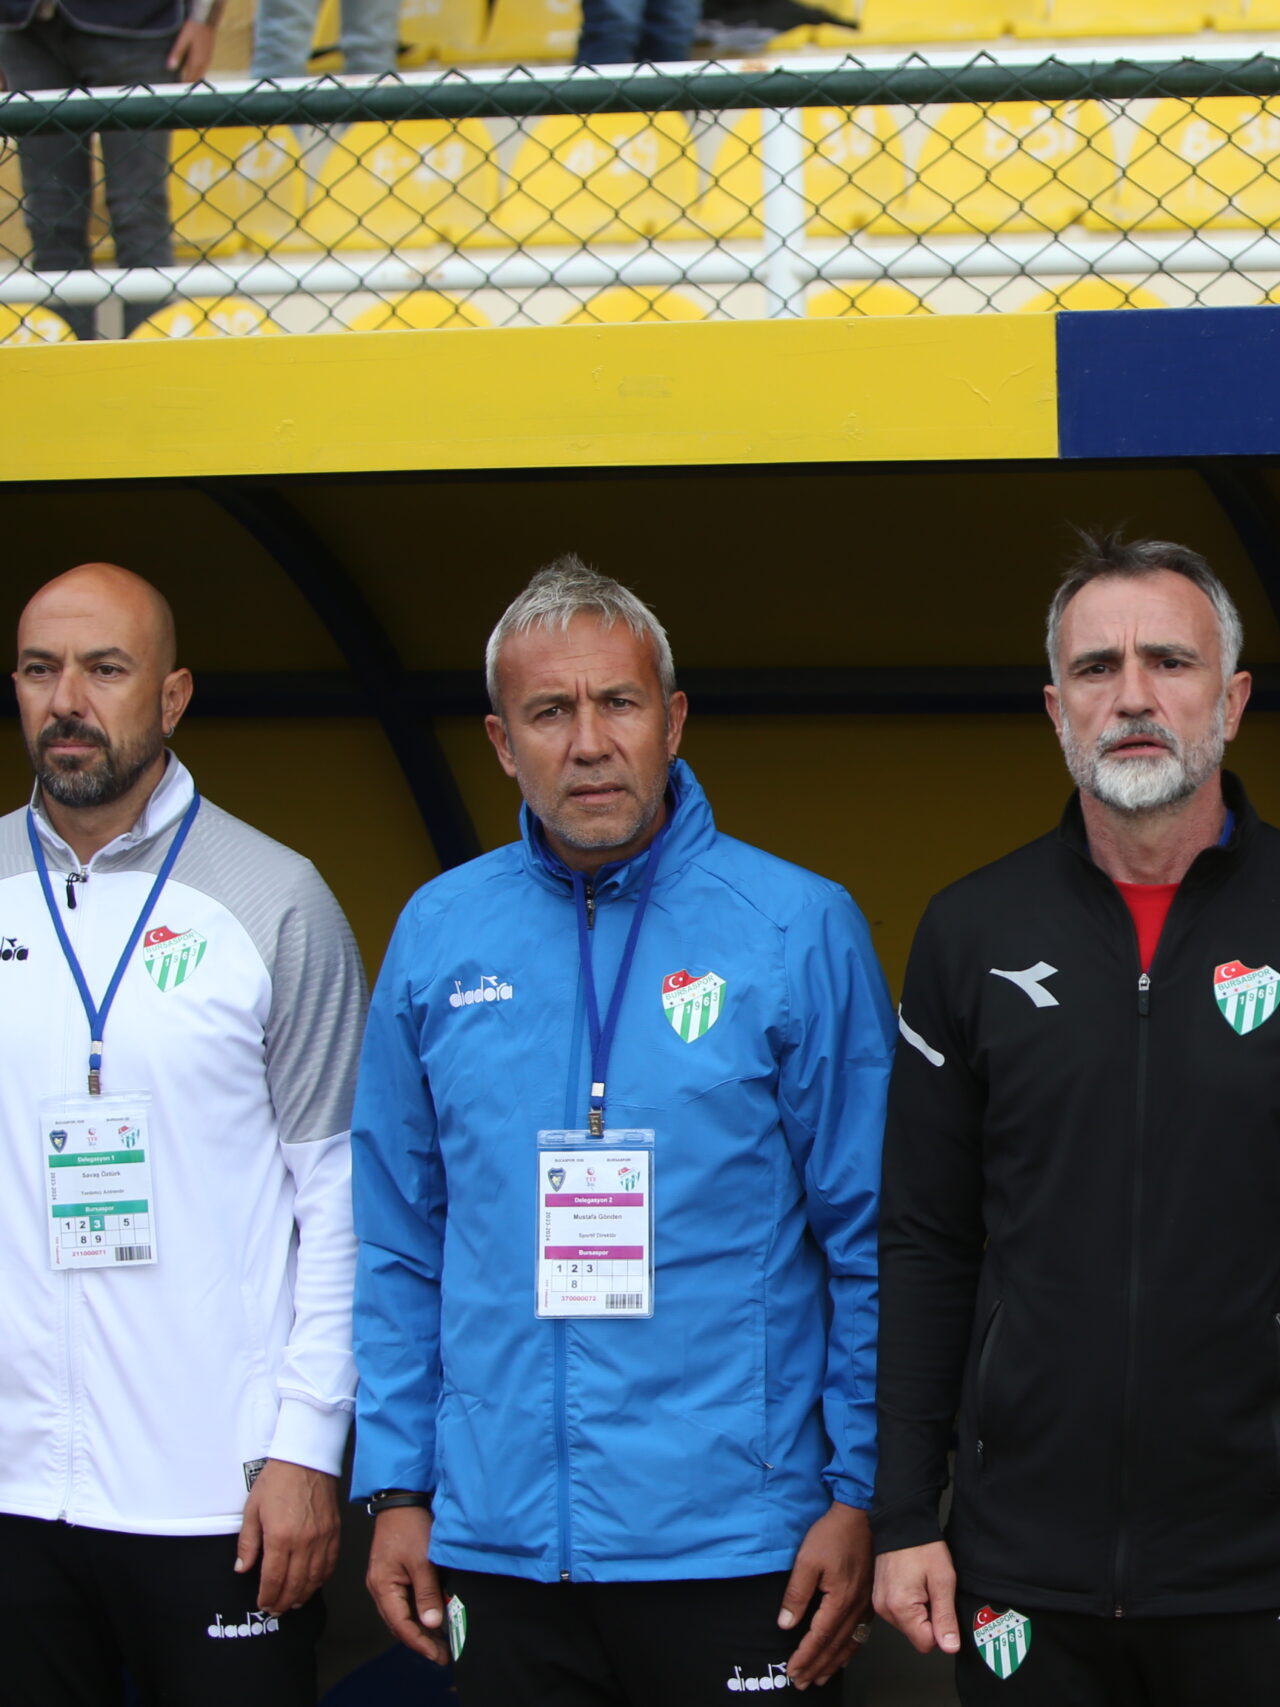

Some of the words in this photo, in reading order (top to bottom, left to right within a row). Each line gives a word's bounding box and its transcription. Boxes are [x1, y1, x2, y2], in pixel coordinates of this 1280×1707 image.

[449, 975, 513, 1008] diadora
[665, 975, 714, 1001] BURSASPOR
[1217, 968, 1271, 991] BURSASPOR
[571, 1264, 578, 1273] 2
[586, 1264, 593, 1273] 3
[571, 1280, 578, 1289] 8
[207, 1611, 279, 1639] diadora
[975, 1612, 1015, 1638] BURSASPOR
